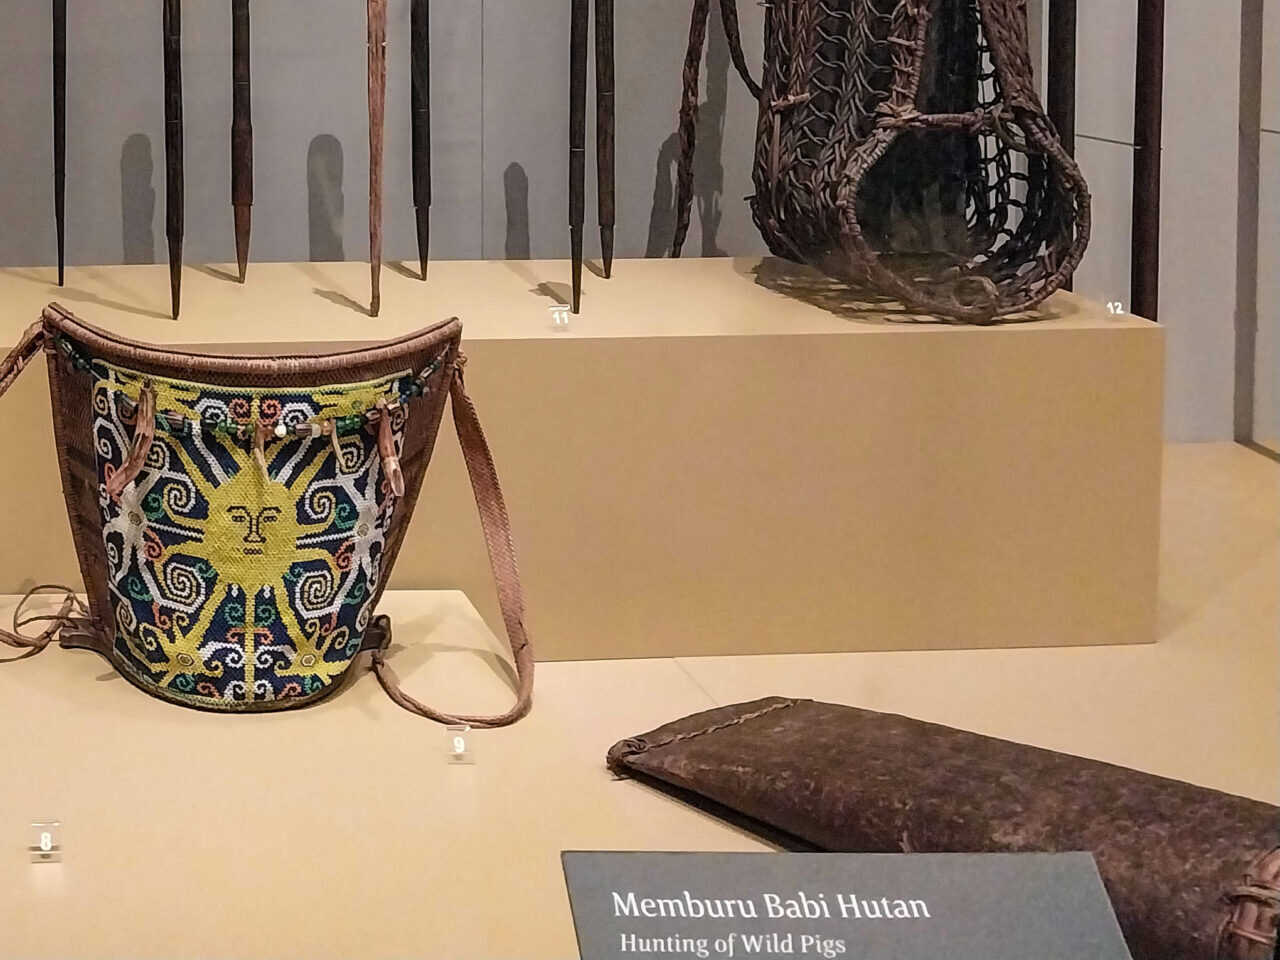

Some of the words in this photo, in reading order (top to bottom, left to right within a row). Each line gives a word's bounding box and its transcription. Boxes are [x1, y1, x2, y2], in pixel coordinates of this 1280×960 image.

[1106, 301, 1125, 315] 12
[552, 311, 569, 325] 11
[453, 736, 465, 753] 9
[40, 831, 52, 851] 8
[611, 890, 757, 919] Memburu
[762, 890, 831, 919] Babi
[835, 892, 931, 919] Hutan
[620, 932, 710, 959] Hunting
[714, 932, 737, 958] of
[740, 932, 794, 954] Wild
[800, 933, 847, 959] Pigs
